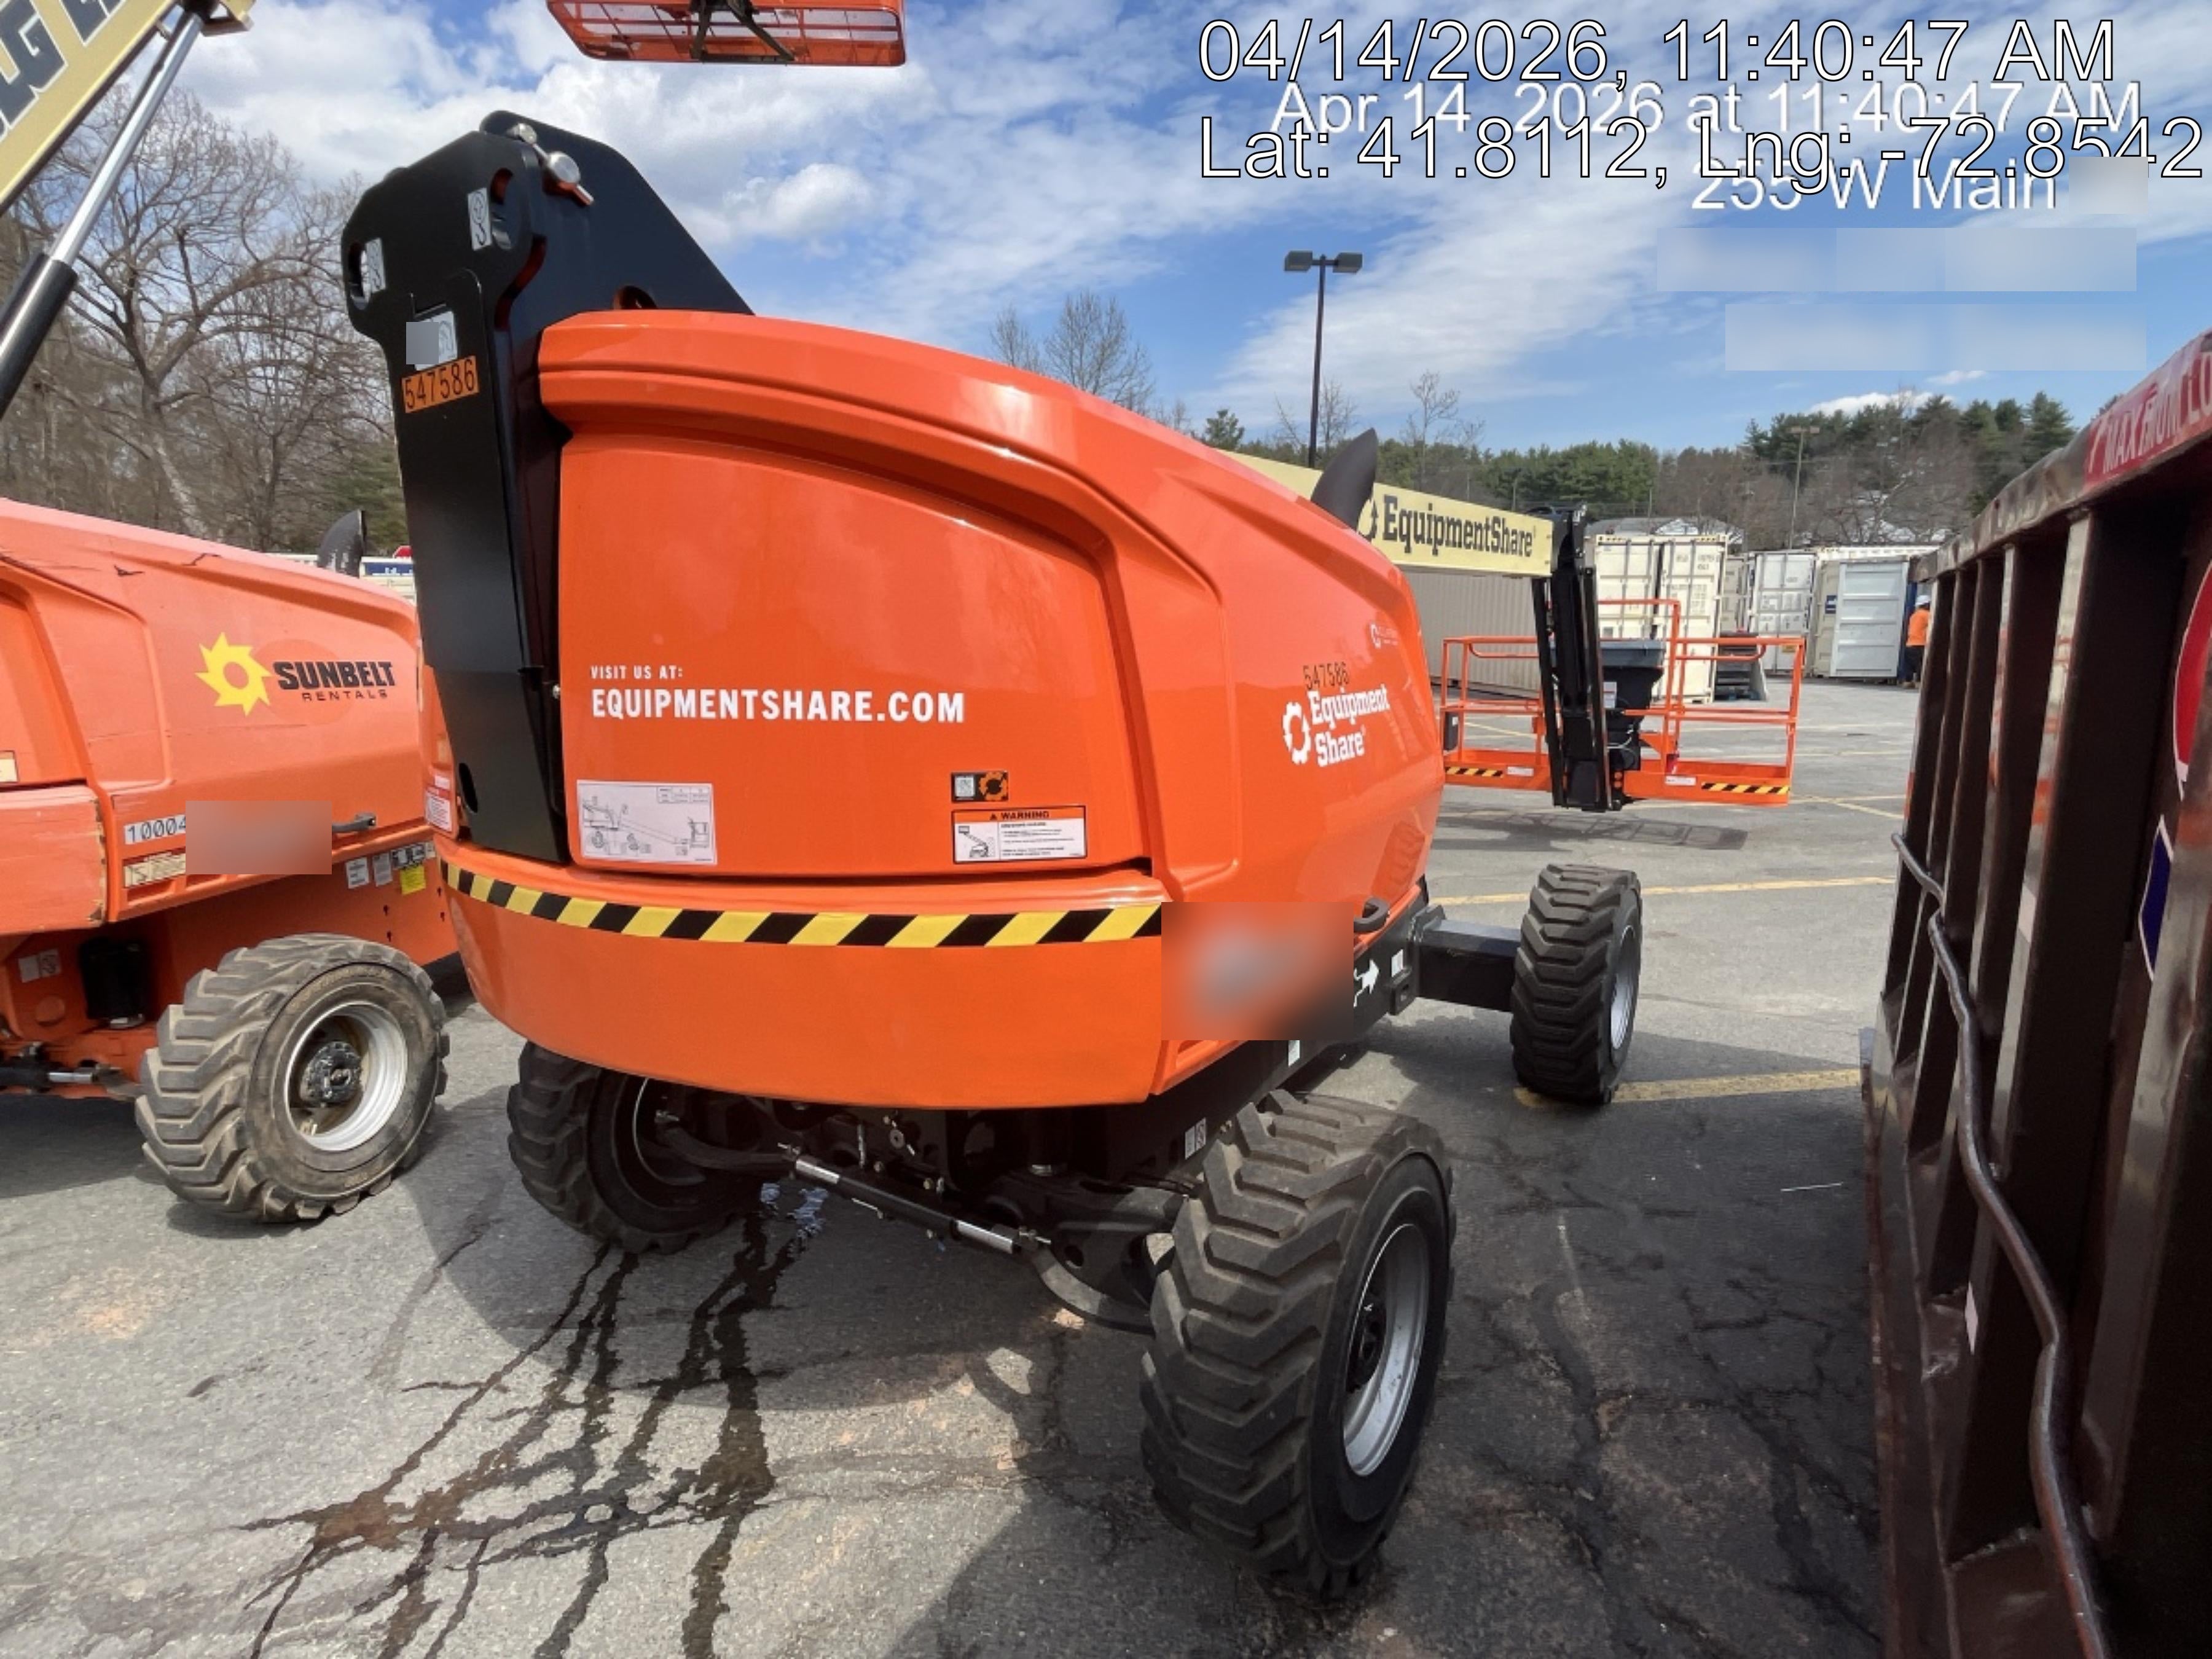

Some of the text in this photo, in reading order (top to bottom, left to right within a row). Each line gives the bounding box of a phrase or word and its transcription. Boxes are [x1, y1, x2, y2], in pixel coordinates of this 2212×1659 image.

[405, 358, 474, 409] 547586
[1383, 495, 1532, 557] EquipmentShare
[273, 662, 396, 689] SUNBELT
[590, 665, 683, 680] VISIT US AT:
[1303, 662, 1350, 691] 547586
[302, 689, 388, 702] RENTALS
[592, 689, 965, 723] EQUIPMENTSHARE.COM
[1307, 683, 1390, 730] Equipment
[1314, 731, 1365, 767] Share
[1000, 810, 1049, 820] WARNING
